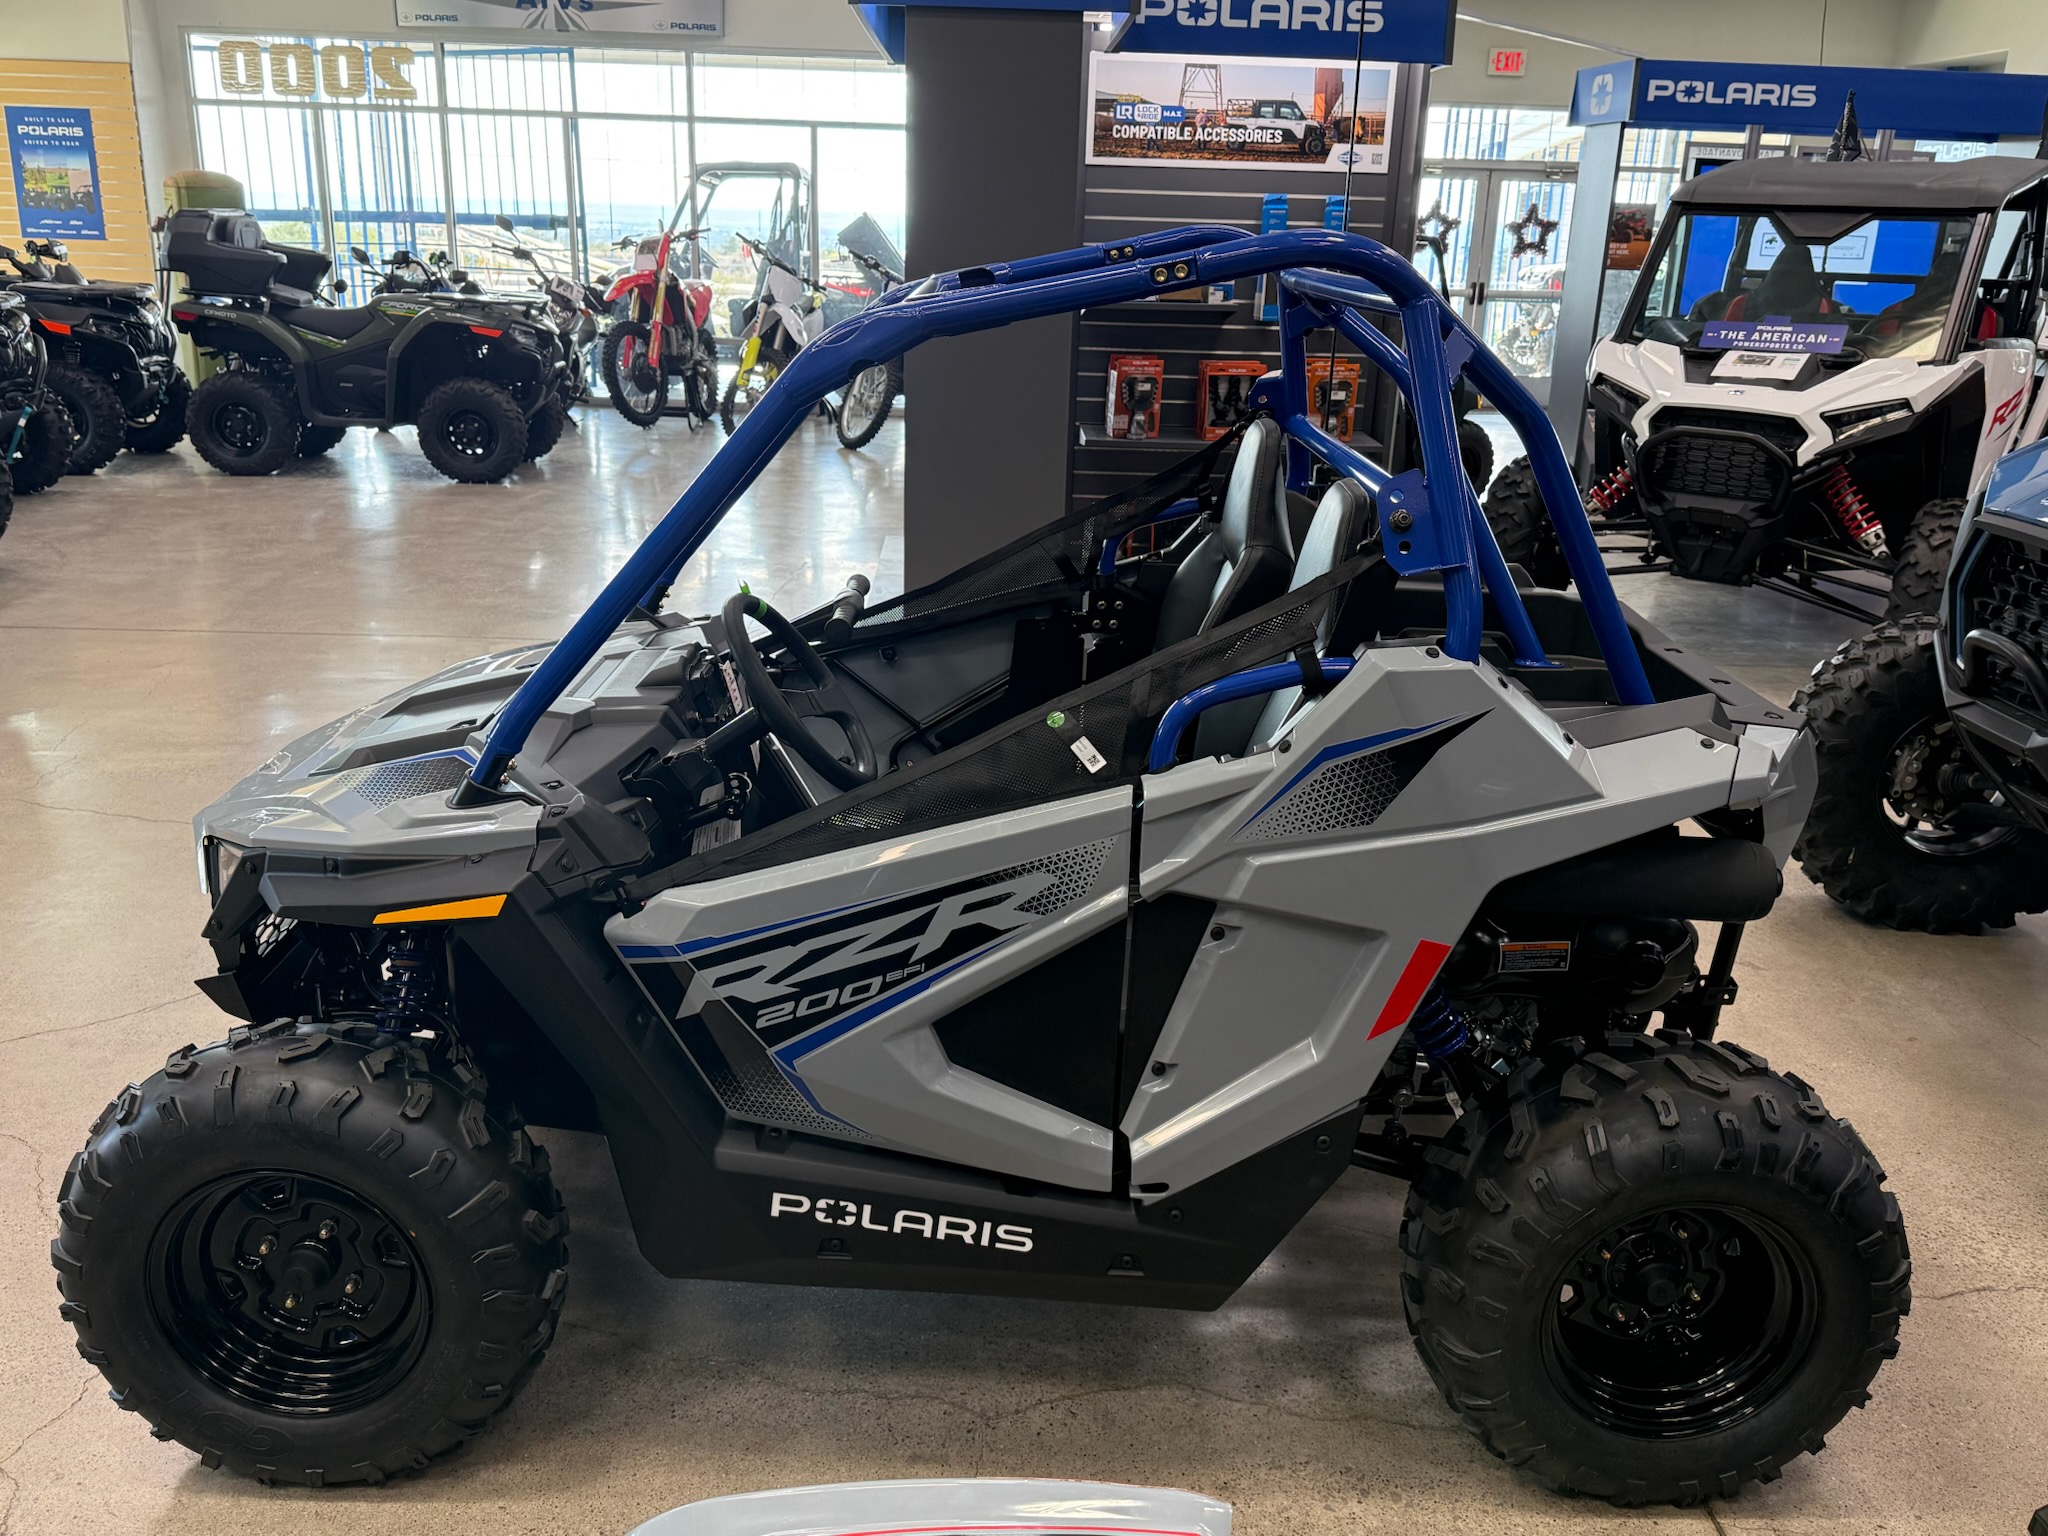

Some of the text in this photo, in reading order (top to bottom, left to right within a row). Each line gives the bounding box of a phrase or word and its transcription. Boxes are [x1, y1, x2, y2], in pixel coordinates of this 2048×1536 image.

[415, 14, 458, 22] POLARIS
[1136, 0, 1383, 33] POLARIS
[670, 22, 716, 31] POLARIS
[1495, 51, 1522, 72] EXIT
[1647, 79, 1817, 107] POLARIS
[1116, 105, 1133, 119] LR
[17, 125, 84, 136] POLARIS
[1112, 124, 1283, 144] COMPATIBLE ACCESSORIES
[380, 300, 427, 311] CFORC
[204, 308, 236, 318] CFMOTO
[1720, 330, 1828, 343] THE AMERICAN
[1733, 341, 1790, 349] POWERSPORTS
[677, 873, 1058, 1019] RZR
[757, 964, 925, 1028] 200 EFI
[770, 1191, 1034, 1253] POLARIS
